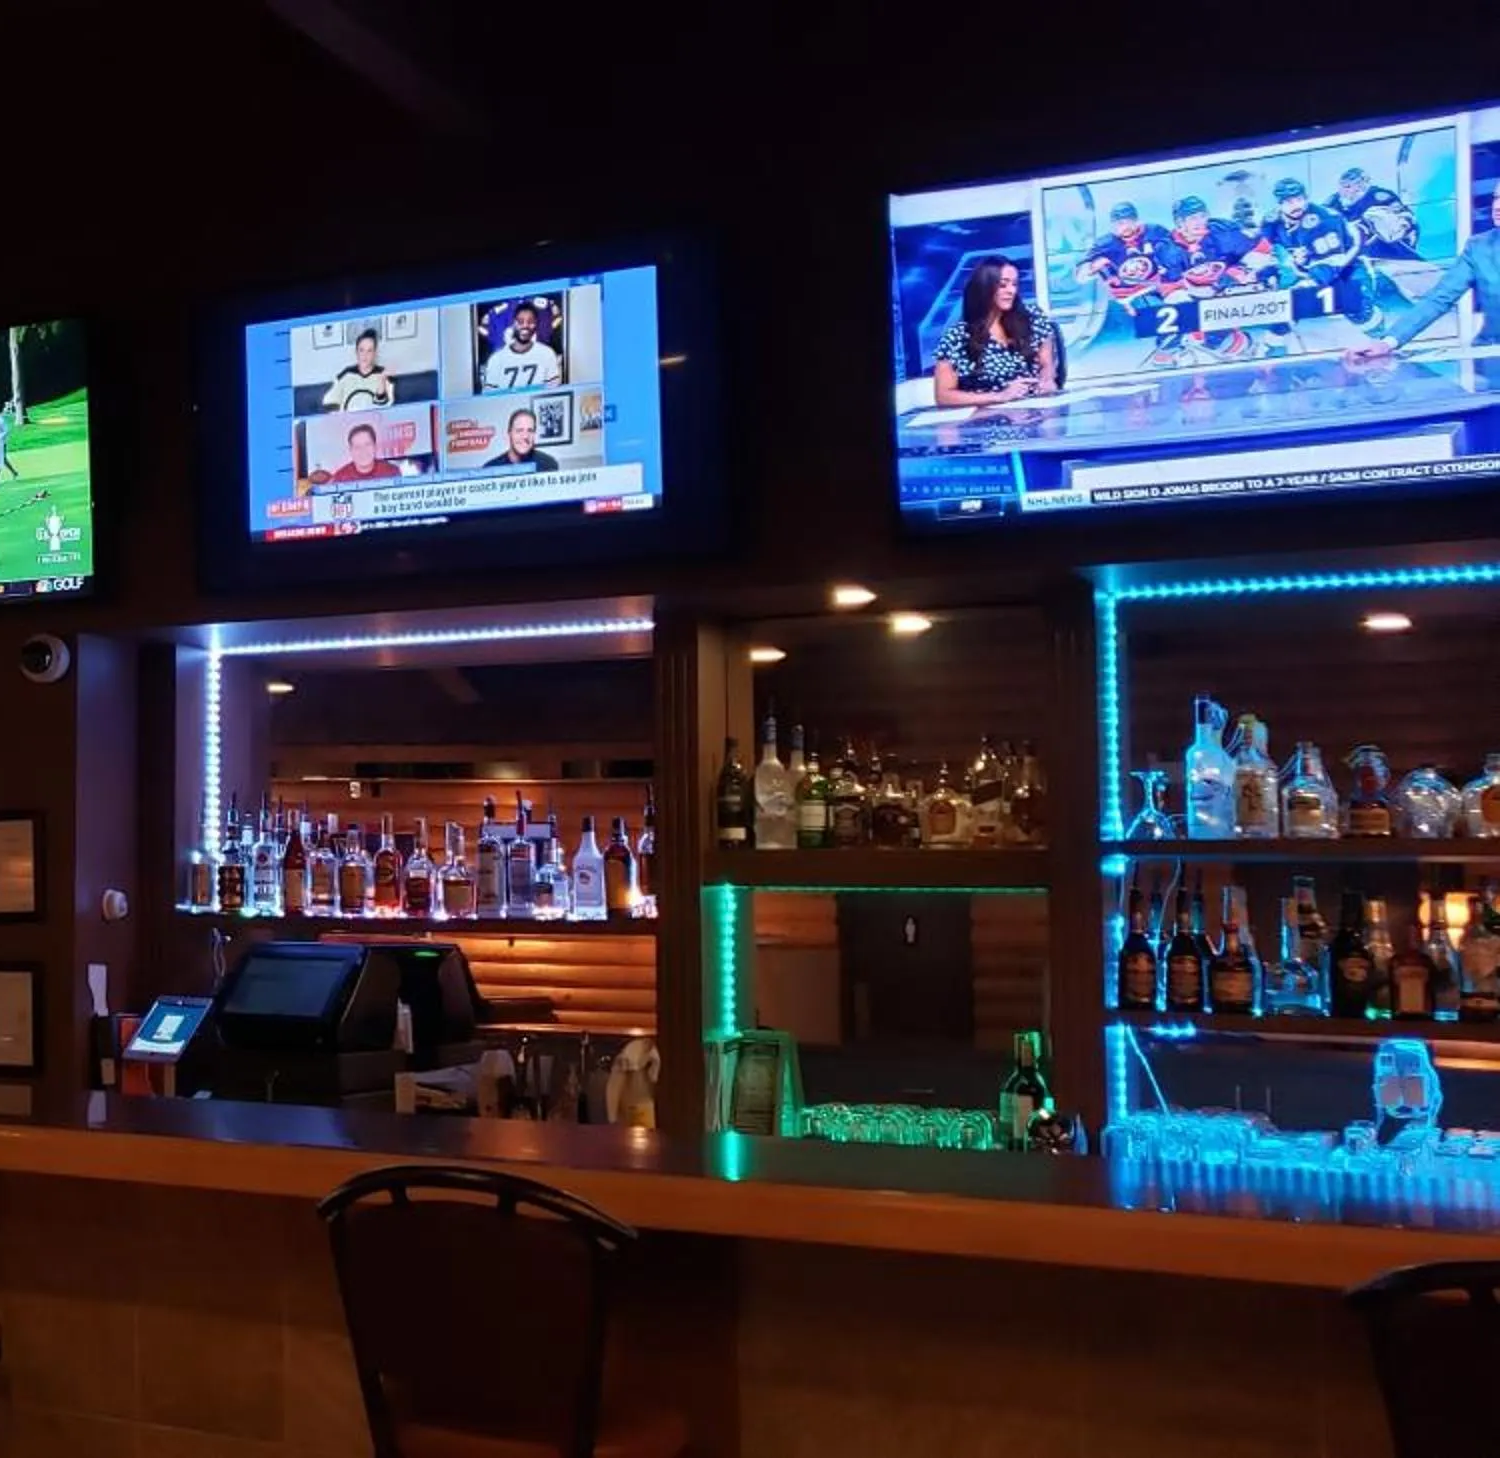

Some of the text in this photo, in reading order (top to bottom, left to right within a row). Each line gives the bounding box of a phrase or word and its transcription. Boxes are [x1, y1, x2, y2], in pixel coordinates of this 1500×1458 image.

[1156, 308, 1179, 334] 2
[1316, 288, 1335, 314] 1
[504, 363, 538, 390] 77
[1247, 478, 1263, 490] TO
[1264, 477, 1275, 488] A
[1363, 465, 1431, 482] CONTRACT
[53, 576, 86, 591] GOLF
